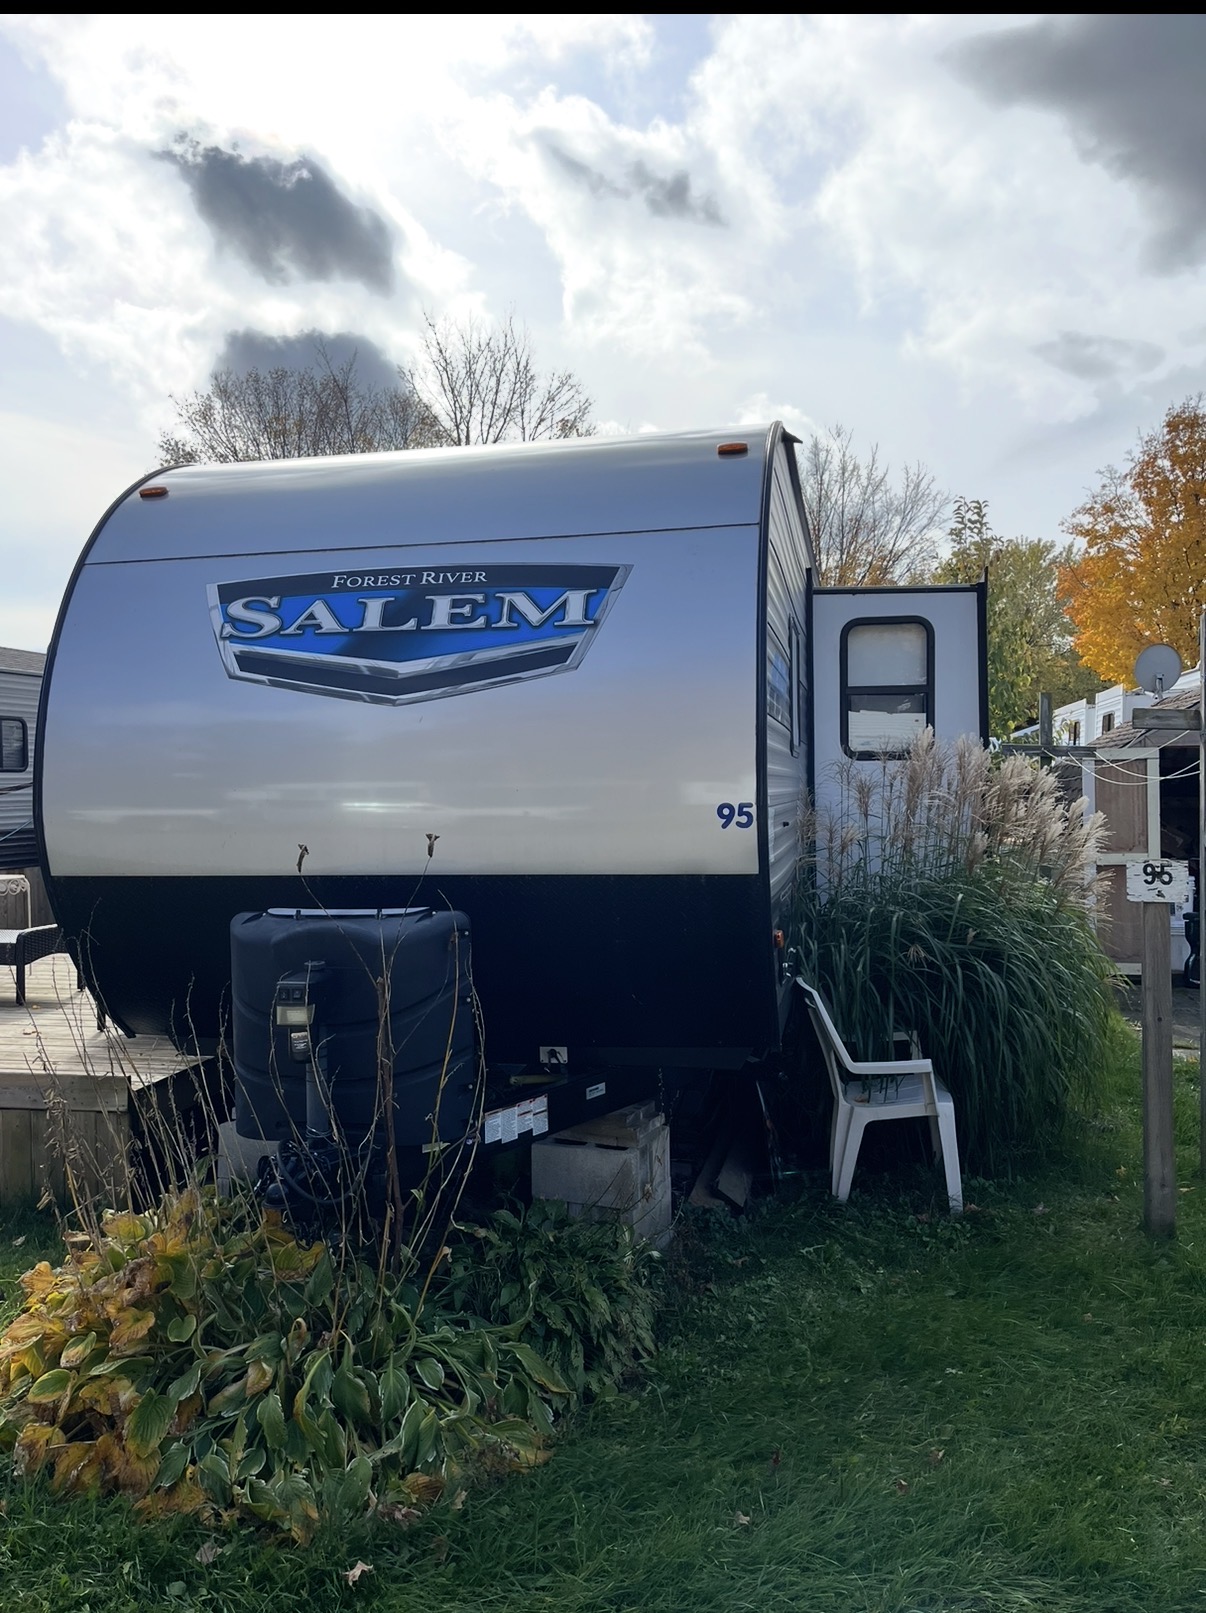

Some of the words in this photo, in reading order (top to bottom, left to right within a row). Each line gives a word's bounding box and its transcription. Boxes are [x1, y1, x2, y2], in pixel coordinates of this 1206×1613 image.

[331, 574, 416, 588] FOREST
[420, 571, 487, 584] RIVER
[220, 588, 598, 639] SALEM
[716, 802, 754, 829] 95
[1142, 863, 1174, 886] 95
